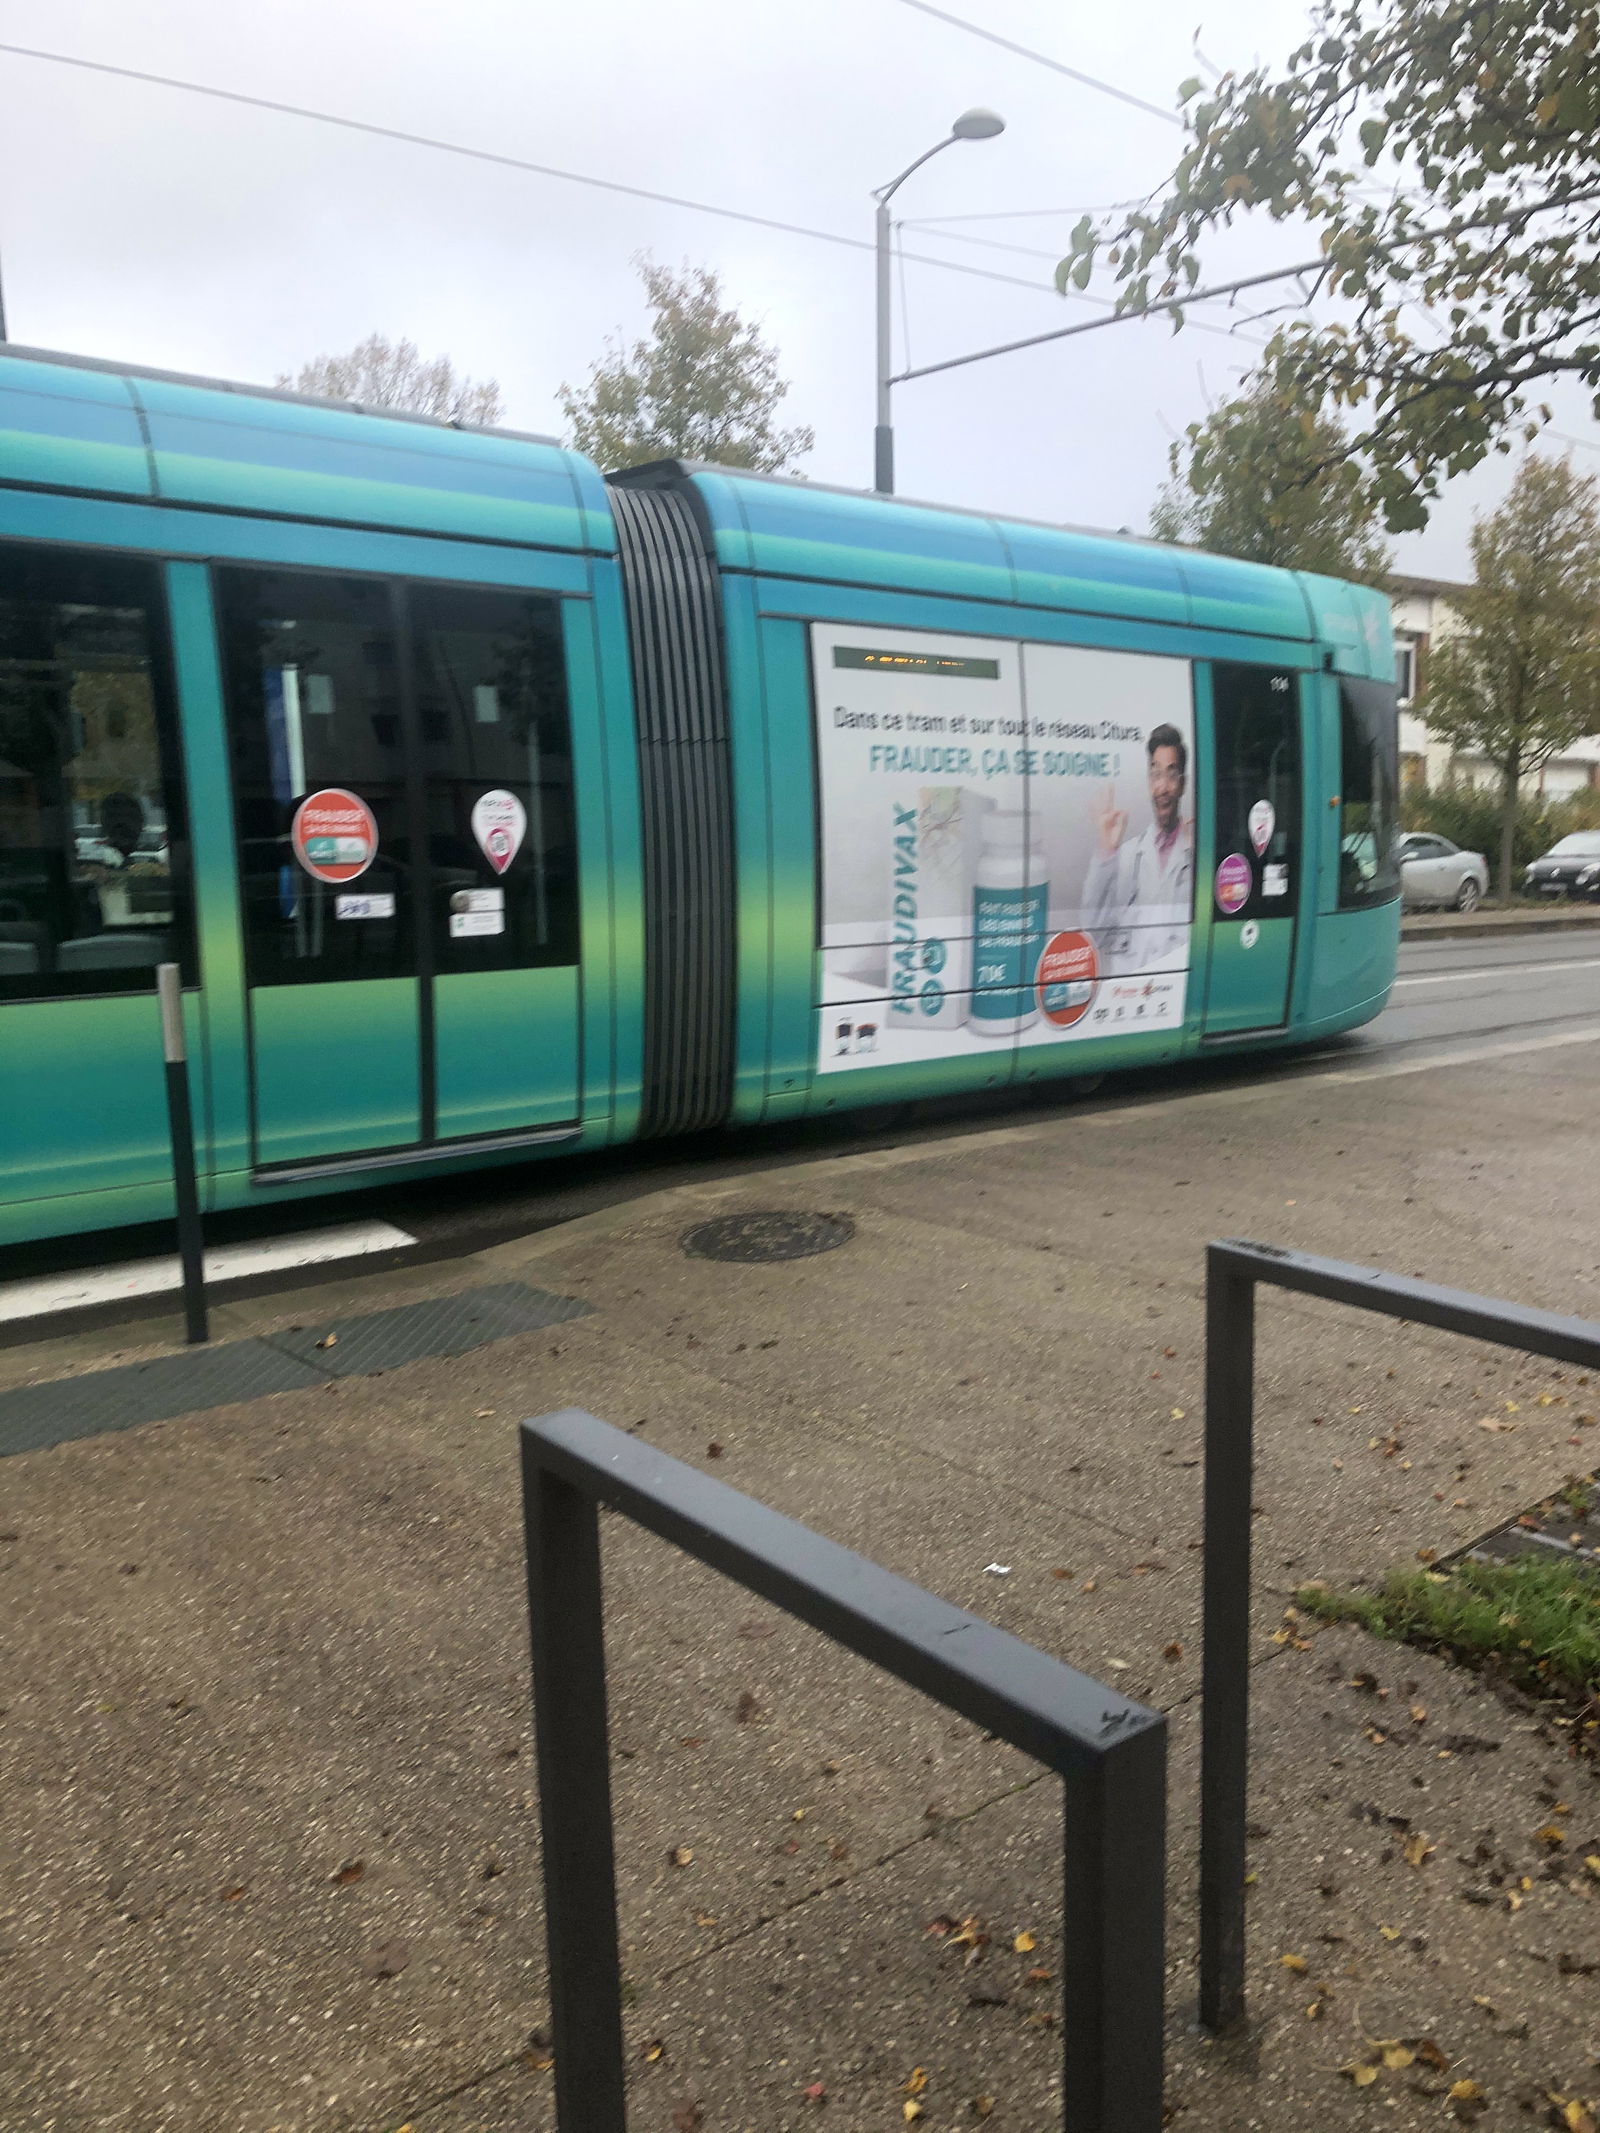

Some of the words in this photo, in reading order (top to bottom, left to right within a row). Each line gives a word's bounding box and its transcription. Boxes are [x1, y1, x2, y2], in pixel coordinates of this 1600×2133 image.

[834, 705, 879, 729] Dans
[882, 712, 903, 730] ce
[906, 711, 948, 732] tram
[950, 713, 968, 733] et
[970, 717, 995, 734] sur
[997, 716, 1030, 737] tout
[1031, 715, 1047, 737] le
[1048, 718, 1097, 740] réseau
[870, 744, 977, 776] FRAUDER,
[981, 748, 1010, 780] ÇA
[1014, 750, 1040, 775] SE
[1043, 751, 1110, 776] SOIGNE
